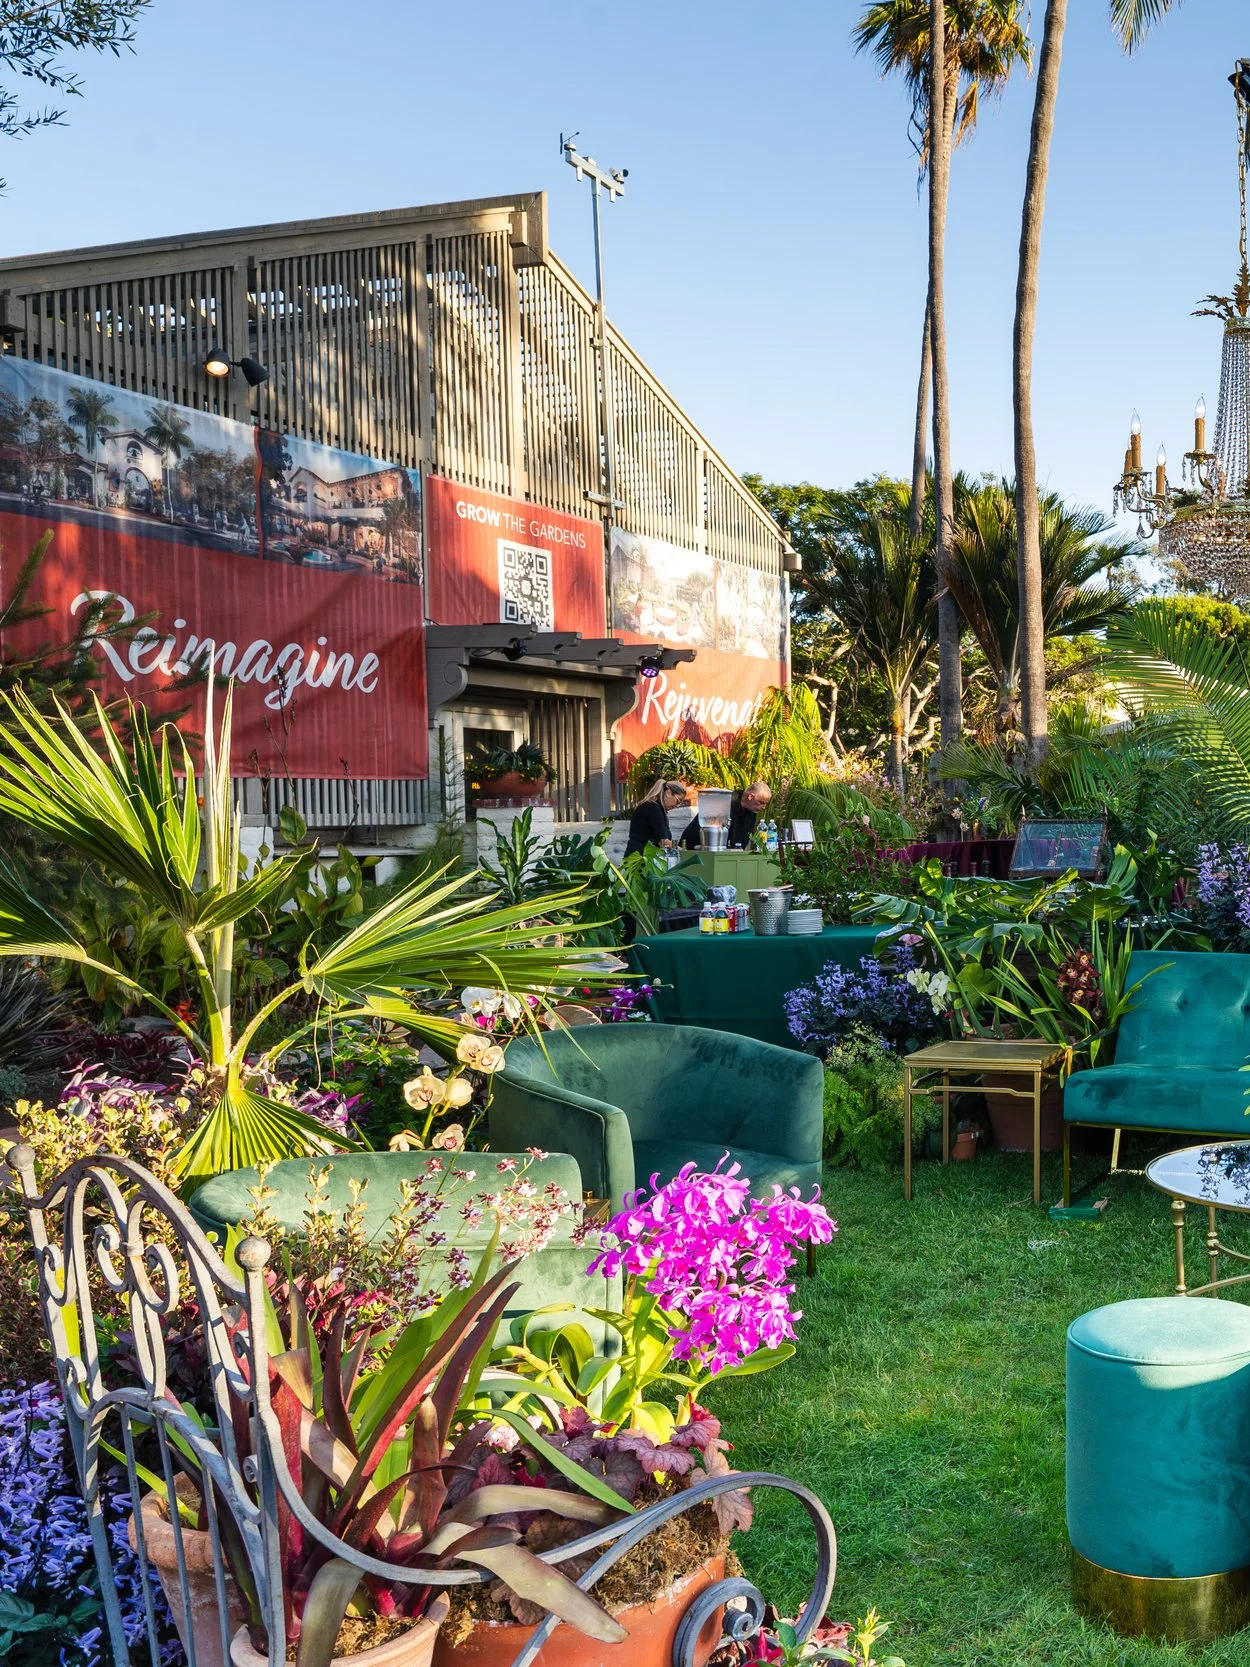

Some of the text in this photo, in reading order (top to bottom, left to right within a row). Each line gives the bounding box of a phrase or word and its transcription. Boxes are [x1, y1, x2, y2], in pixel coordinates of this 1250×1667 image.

[456, 501, 587, 549] GROW THE GARDENS
[70, 590, 379, 710] Reimagine
